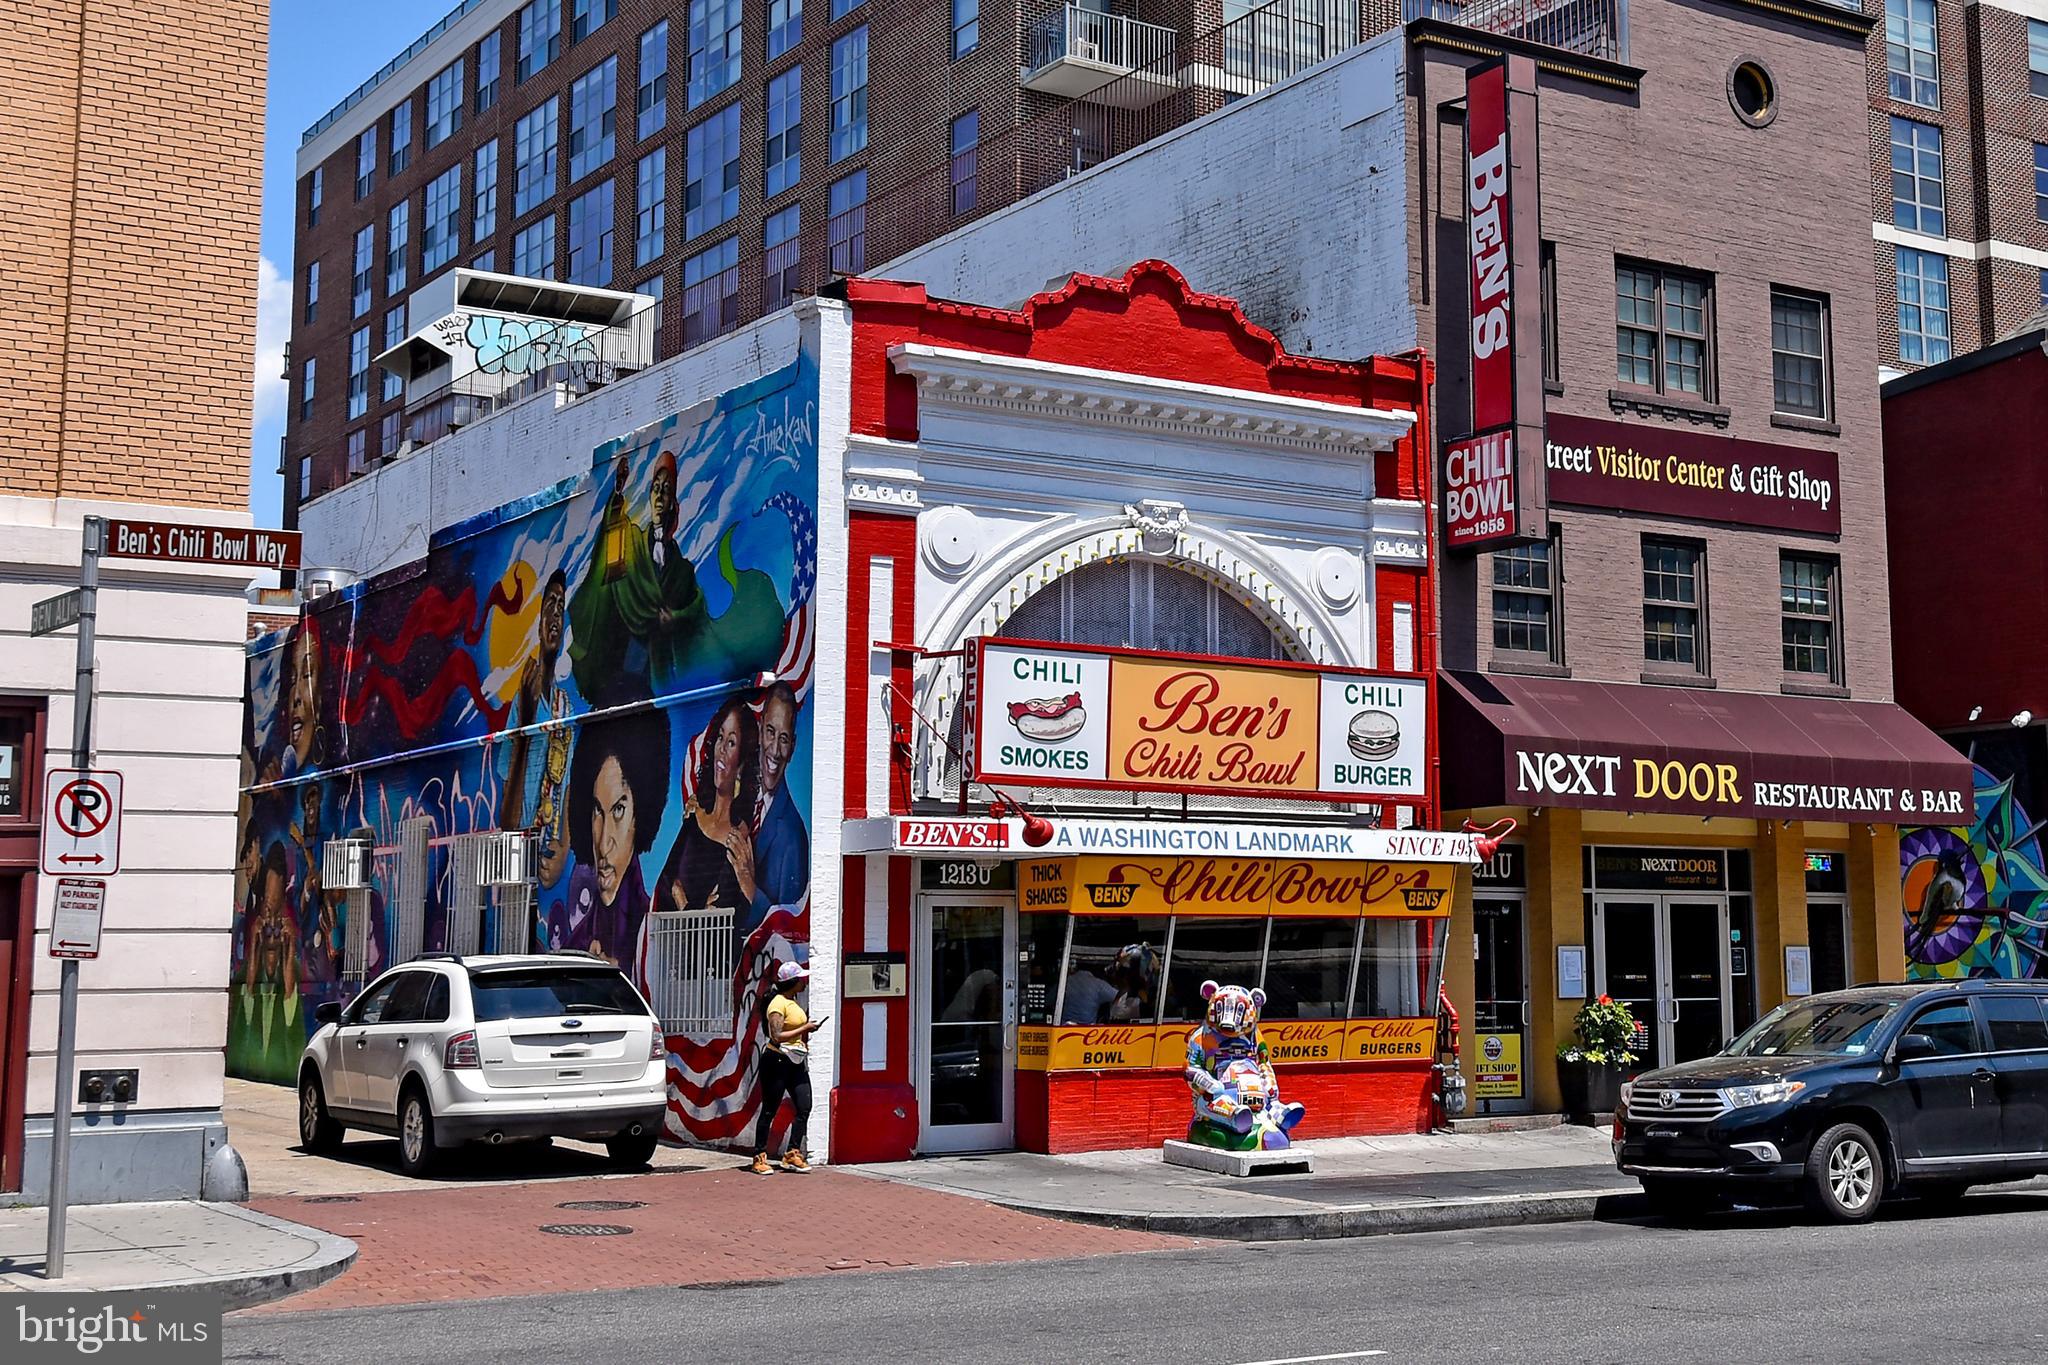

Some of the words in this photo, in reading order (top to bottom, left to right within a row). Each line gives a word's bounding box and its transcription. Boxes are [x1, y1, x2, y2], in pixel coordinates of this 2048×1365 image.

[1469, 132, 1510, 360] BEN'S
[1446, 438, 1512, 488] CHILI
[1597, 446, 1661, 483] Visitor
[1666, 455, 1725, 490] Center
[1729, 463, 1746, 493] &
[1750, 464, 1784, 498] Gift
[1788, 470, 1832, 511] Shop
[1446, 475, 1515, 523] BOWL
[1454, 525, 1474, 537] since
[1474, 517, 1506, 537] 1958
[117, 524, 161, 555] Ben's
[168, 527, 205, 558] Chili
[212, 531, 249, 562] Bowl
[255, 534, 287, 568] Way
[32, 602, 52, 633] BEN
[55, 596, 71, 626] ALI
[1013, 657, 1082, 685] CHILI
[1138, 671, 1292, 740] Ben's
[1344, 684, 1403, 708] CHILI
[963, 640, 977, 779] BEN'S
[1000, 745, 1089, 771] SMOKES
[1124, 738, 1202, 781] Chili
[1208, 743, 1306, 785] Bowl
[1333, 764, 1412, 787] BURGER
[1633, 759, 1742, 804] DOOR
[1754, 782, 1894, 812] RESTAURANT
[1899, 789, 1917, 812] &
[1922, 790, 1965, 814] BAR
[1057, 827, 1072, 846] A
[1078, 827, 1229, 851] WASHINGTON
[1236, 831, 1354, 854] LANDMARK
[1385, 836, 1444, 857] SINCE
[1030, 864, 1062, 882] THICK
[1162, 859, 1272, 904] Chili
[1275, 860, 1394, 905] Bowl
[62, 890, 72, 898] NO
[72, 891, 99, 899] PARKING
[1026, 886, 1067, 905] SHAKES
[1093, 886, 1131, 903] BEN'S
[1407, 891, 1440, 908] BEN'S
[1076, 1028, 1142, 1046] Chili
[1273, 1023, 1331, 1042] Chili
[1365, 1022, 1421, 1039] Chili
[1083, 1052, 1125, 1064] BOWL
[1271, 1045, 1329, 1058] SMOKES
[1359, 1042, 1422, 1055] BURGERS
[1492, 1063, 1517, 1073] SHOP
